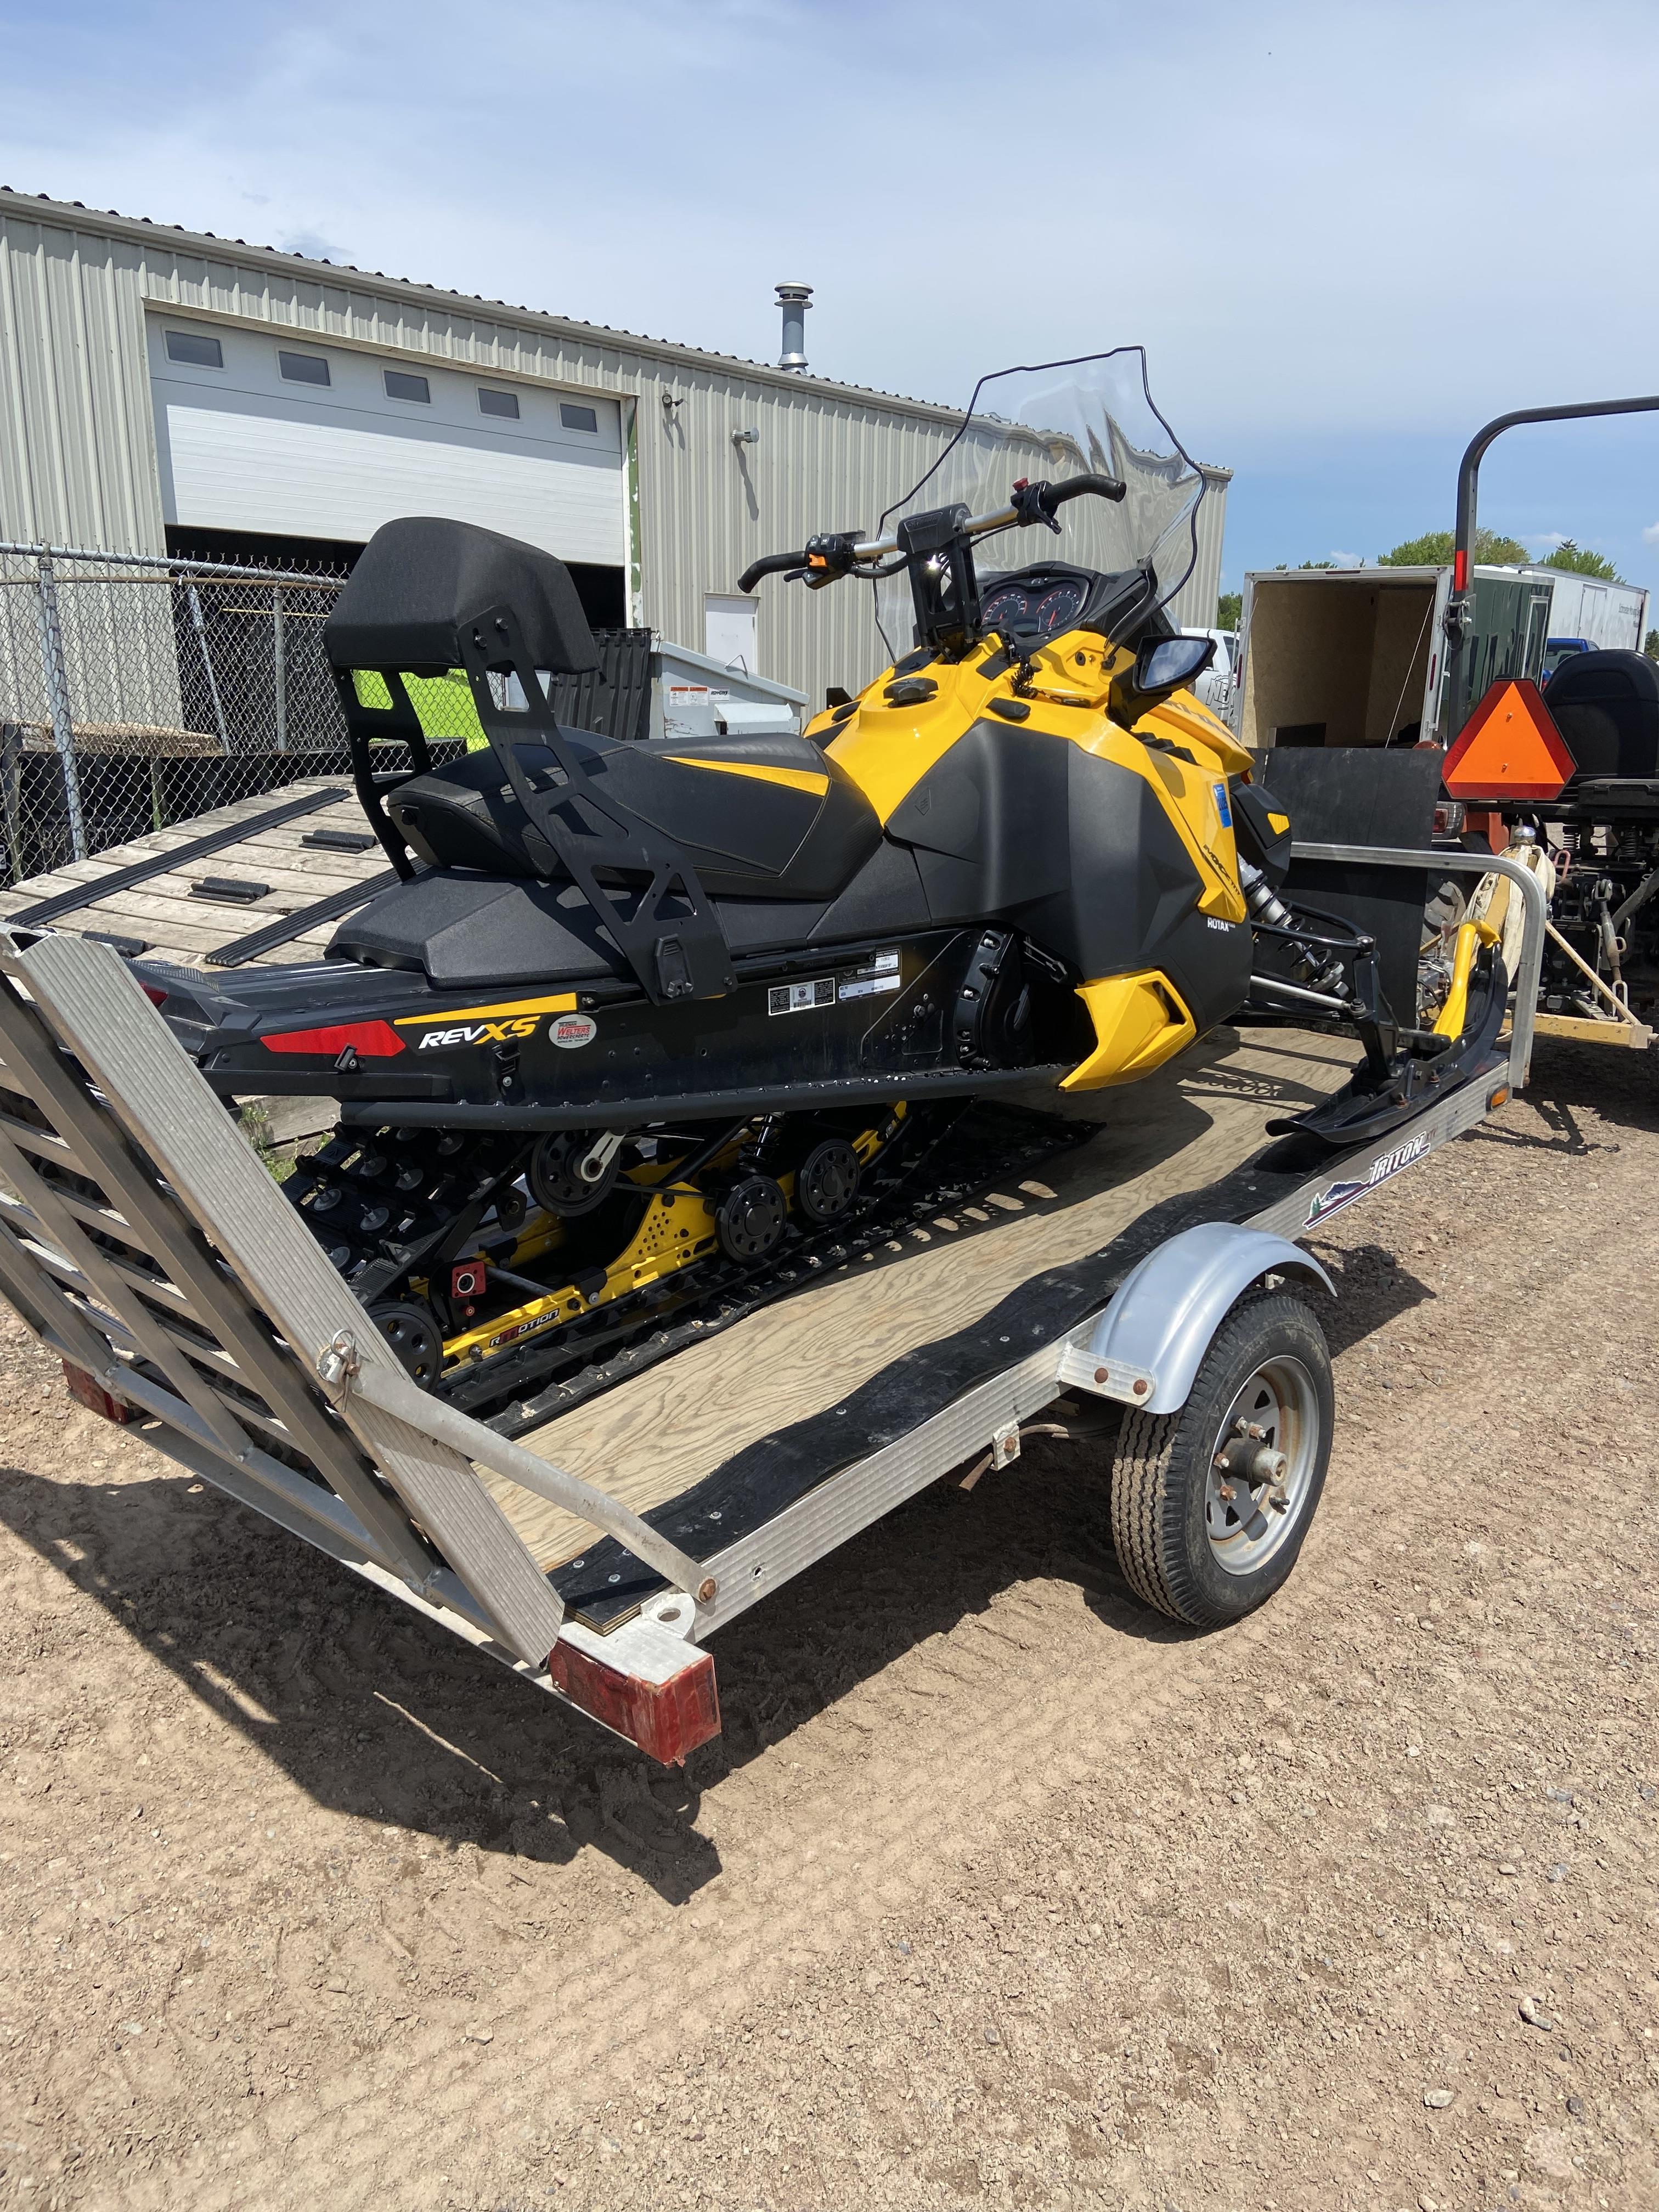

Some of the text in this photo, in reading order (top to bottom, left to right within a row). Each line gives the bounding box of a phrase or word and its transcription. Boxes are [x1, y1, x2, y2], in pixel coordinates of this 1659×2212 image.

[1207, 917, 1229, 932] ROTAX
[557, 1026, 590, 1036] WELTERS
[1369, 1132, 1425, 1184] TRITON
